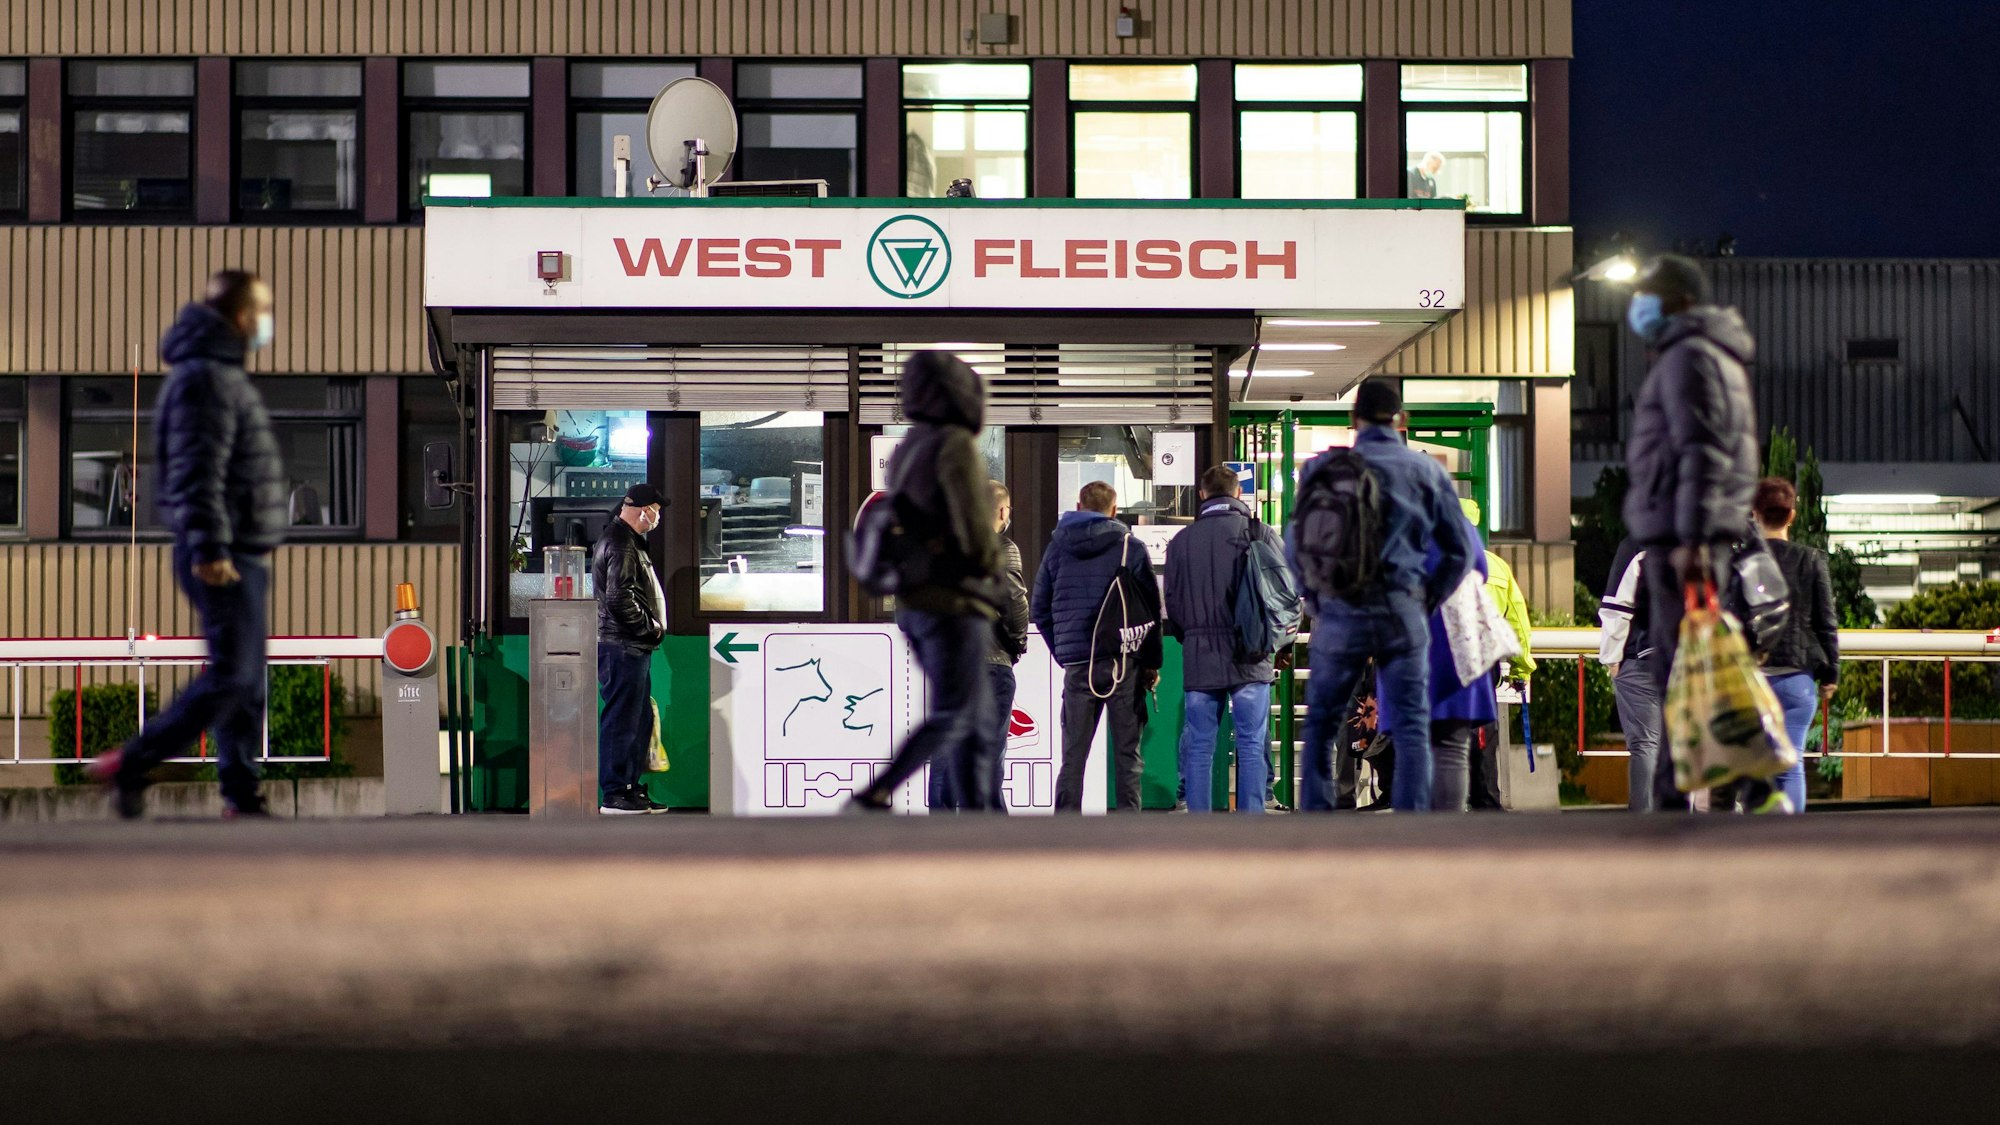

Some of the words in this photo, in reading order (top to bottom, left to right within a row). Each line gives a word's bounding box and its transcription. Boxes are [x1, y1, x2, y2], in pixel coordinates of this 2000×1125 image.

[613, 238, 842, 278] WEST
[974, 240, 1297, 280] FLEISCH
[1419, 289, 1445, 308] 32
